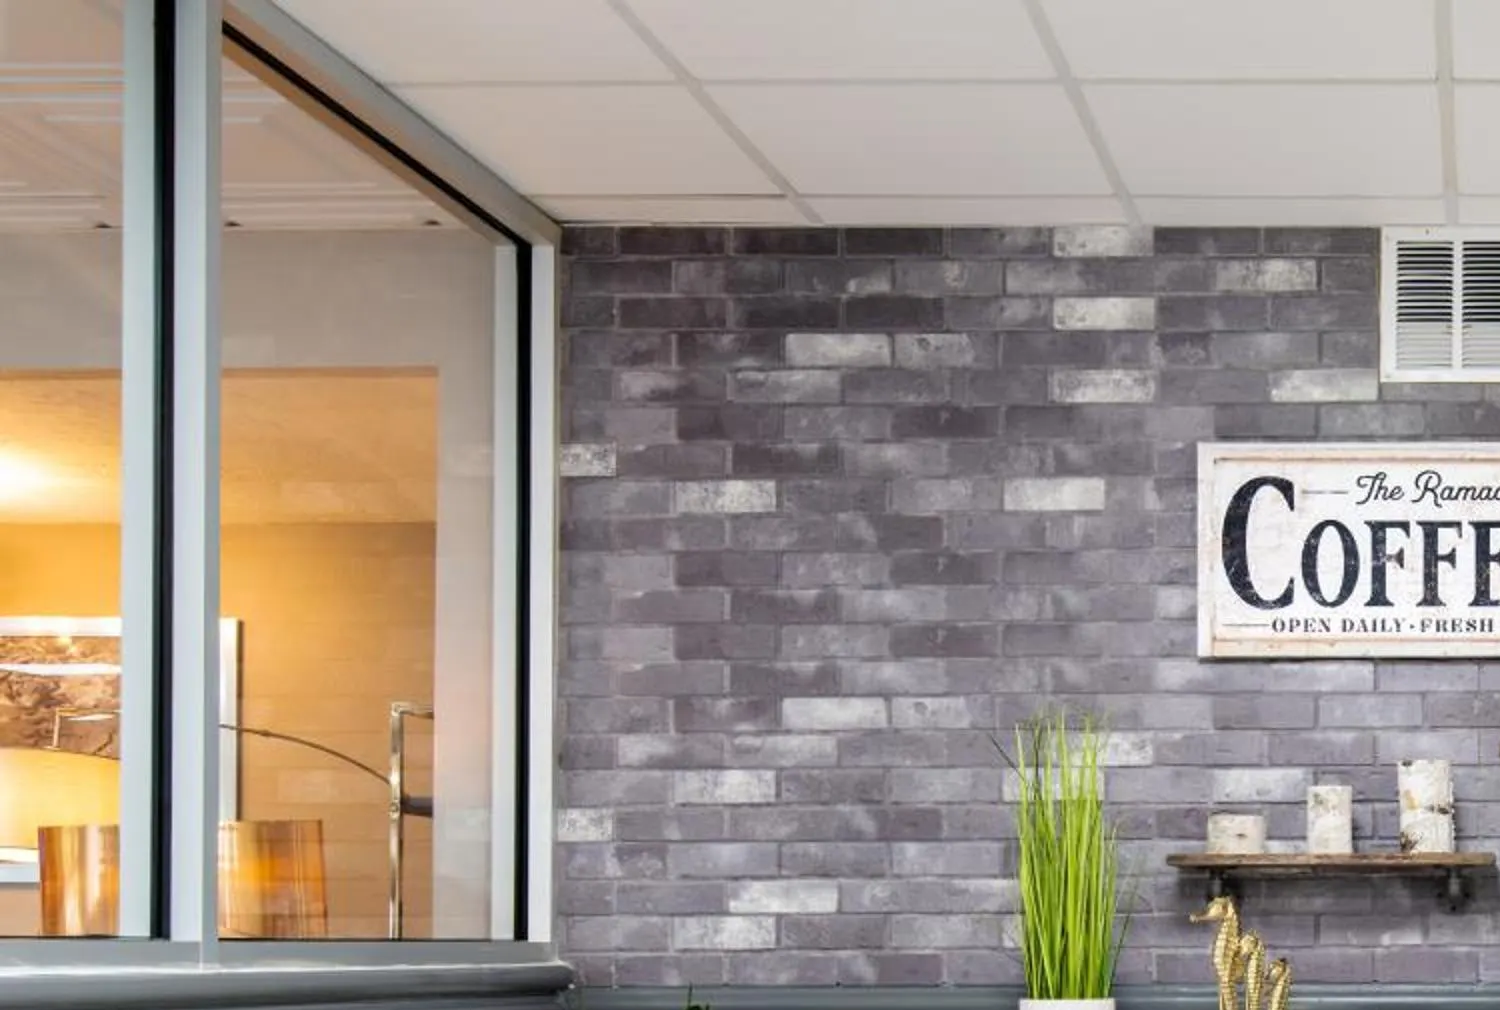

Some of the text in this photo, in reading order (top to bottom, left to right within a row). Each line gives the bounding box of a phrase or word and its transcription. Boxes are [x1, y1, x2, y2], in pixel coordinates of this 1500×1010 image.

[1355, 471, 1405, 505] The
[1271, 617, 1332, 634] OPEN
[1341, 617, 1406, 634] DAILY
[1420, 617, 1495, 634] FRESH
